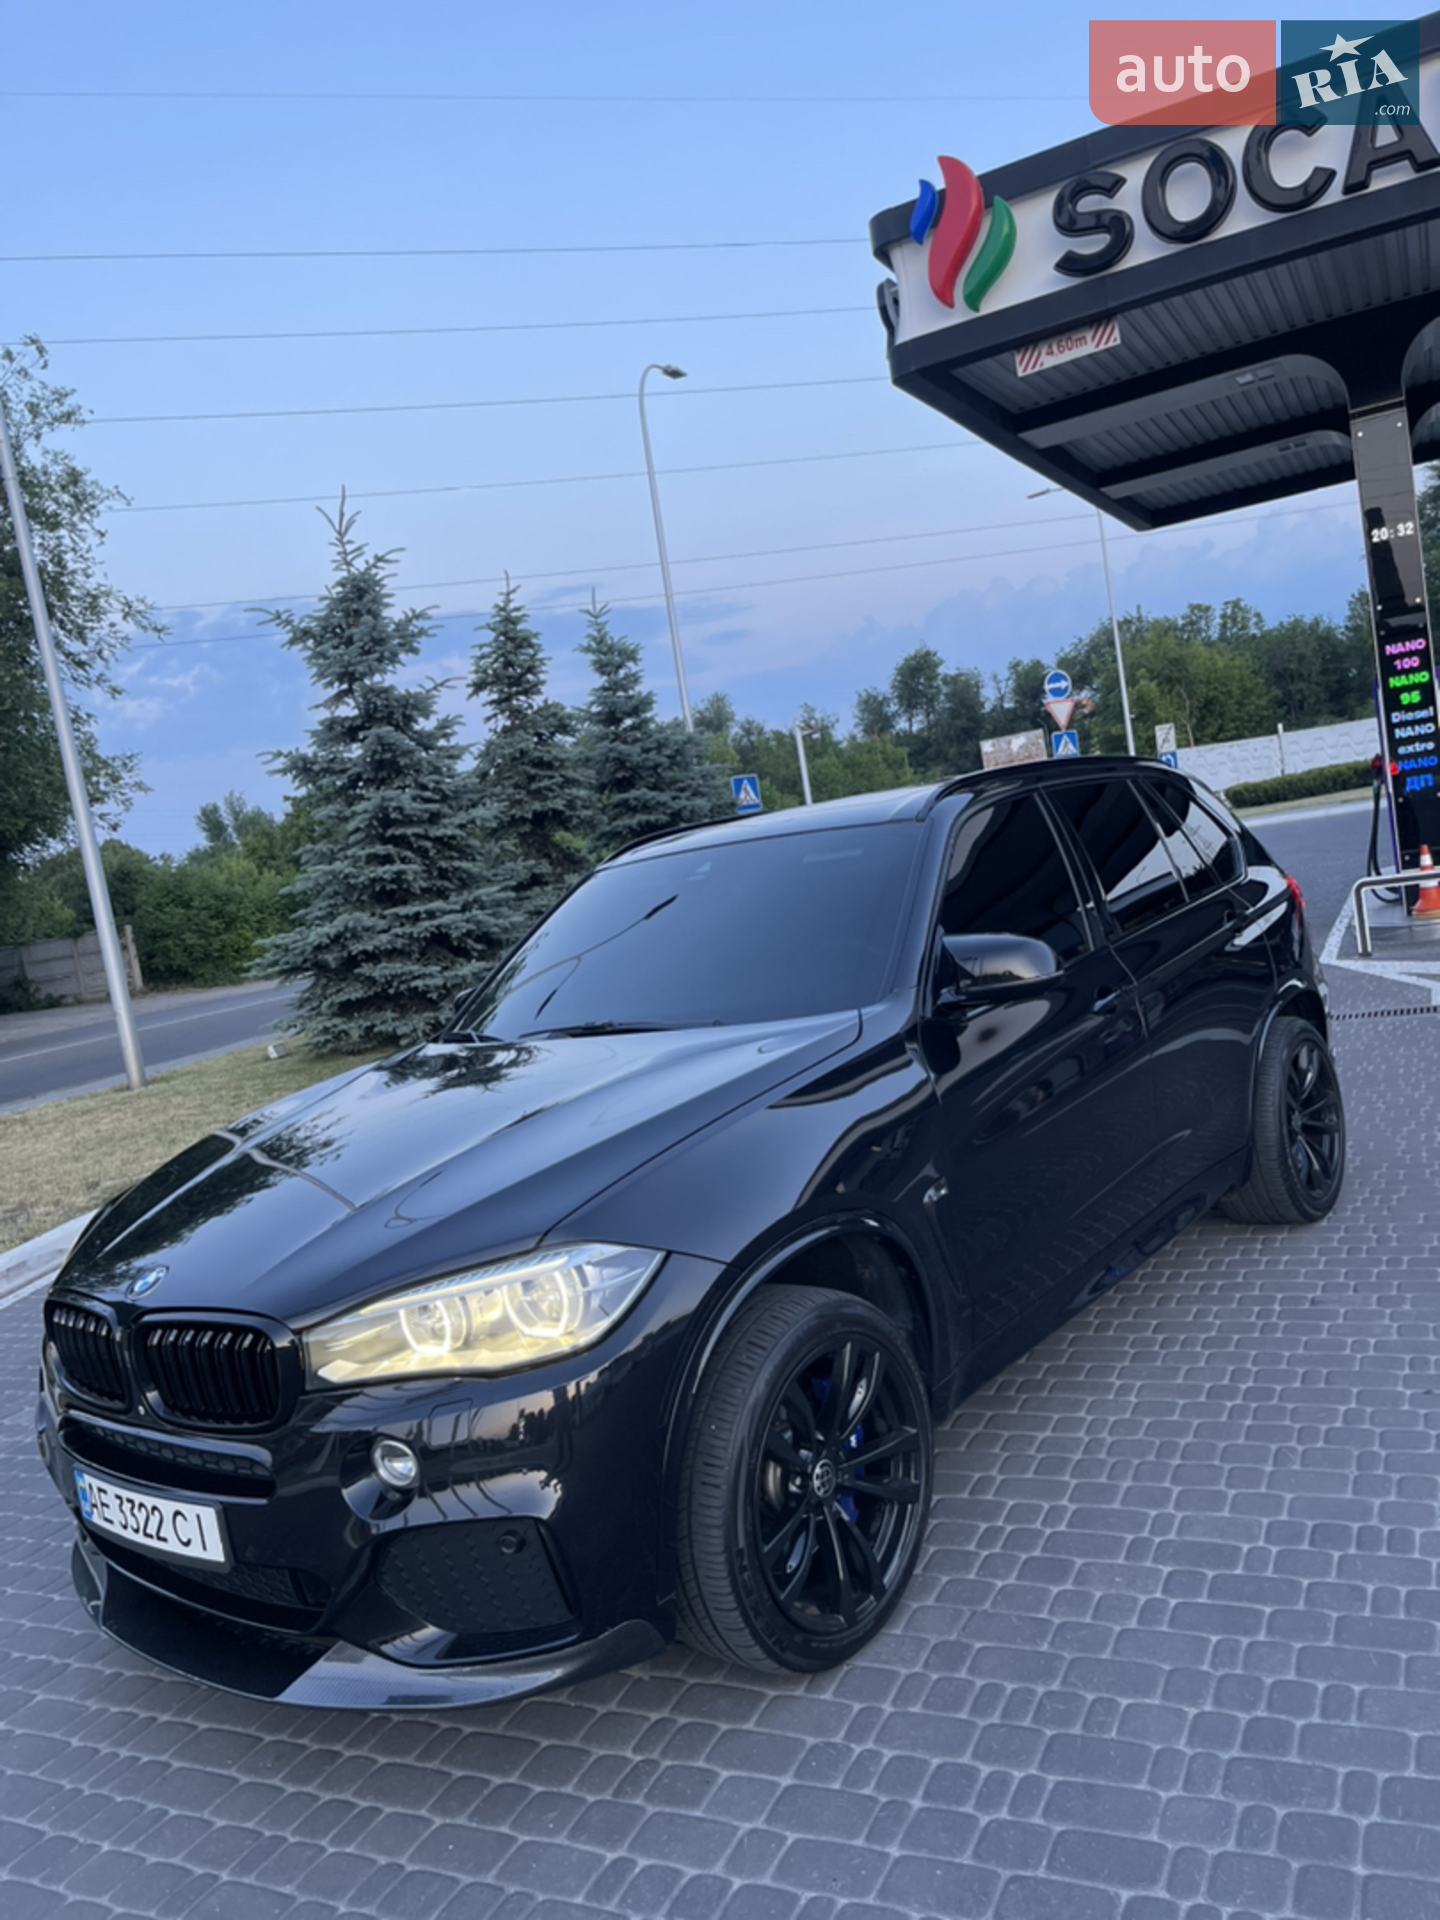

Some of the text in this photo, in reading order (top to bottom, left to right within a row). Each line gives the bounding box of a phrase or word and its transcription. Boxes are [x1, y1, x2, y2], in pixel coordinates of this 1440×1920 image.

[1385, 638, 1426, 655] NANO
[1394, 656, 1420, 670] 100
[1388, 671, 1430, 689] NANO
[1399, 690, 1422, 706] 95
[1391, 706, 1434, 724] Diesel
[1394, 723, 1435, 740] NANO
[1397, 756, 1438, 772] NANO
[1404, 774, 1433, 793] ДП
[87, 1482, 207, 1552] AE 3322 CI
